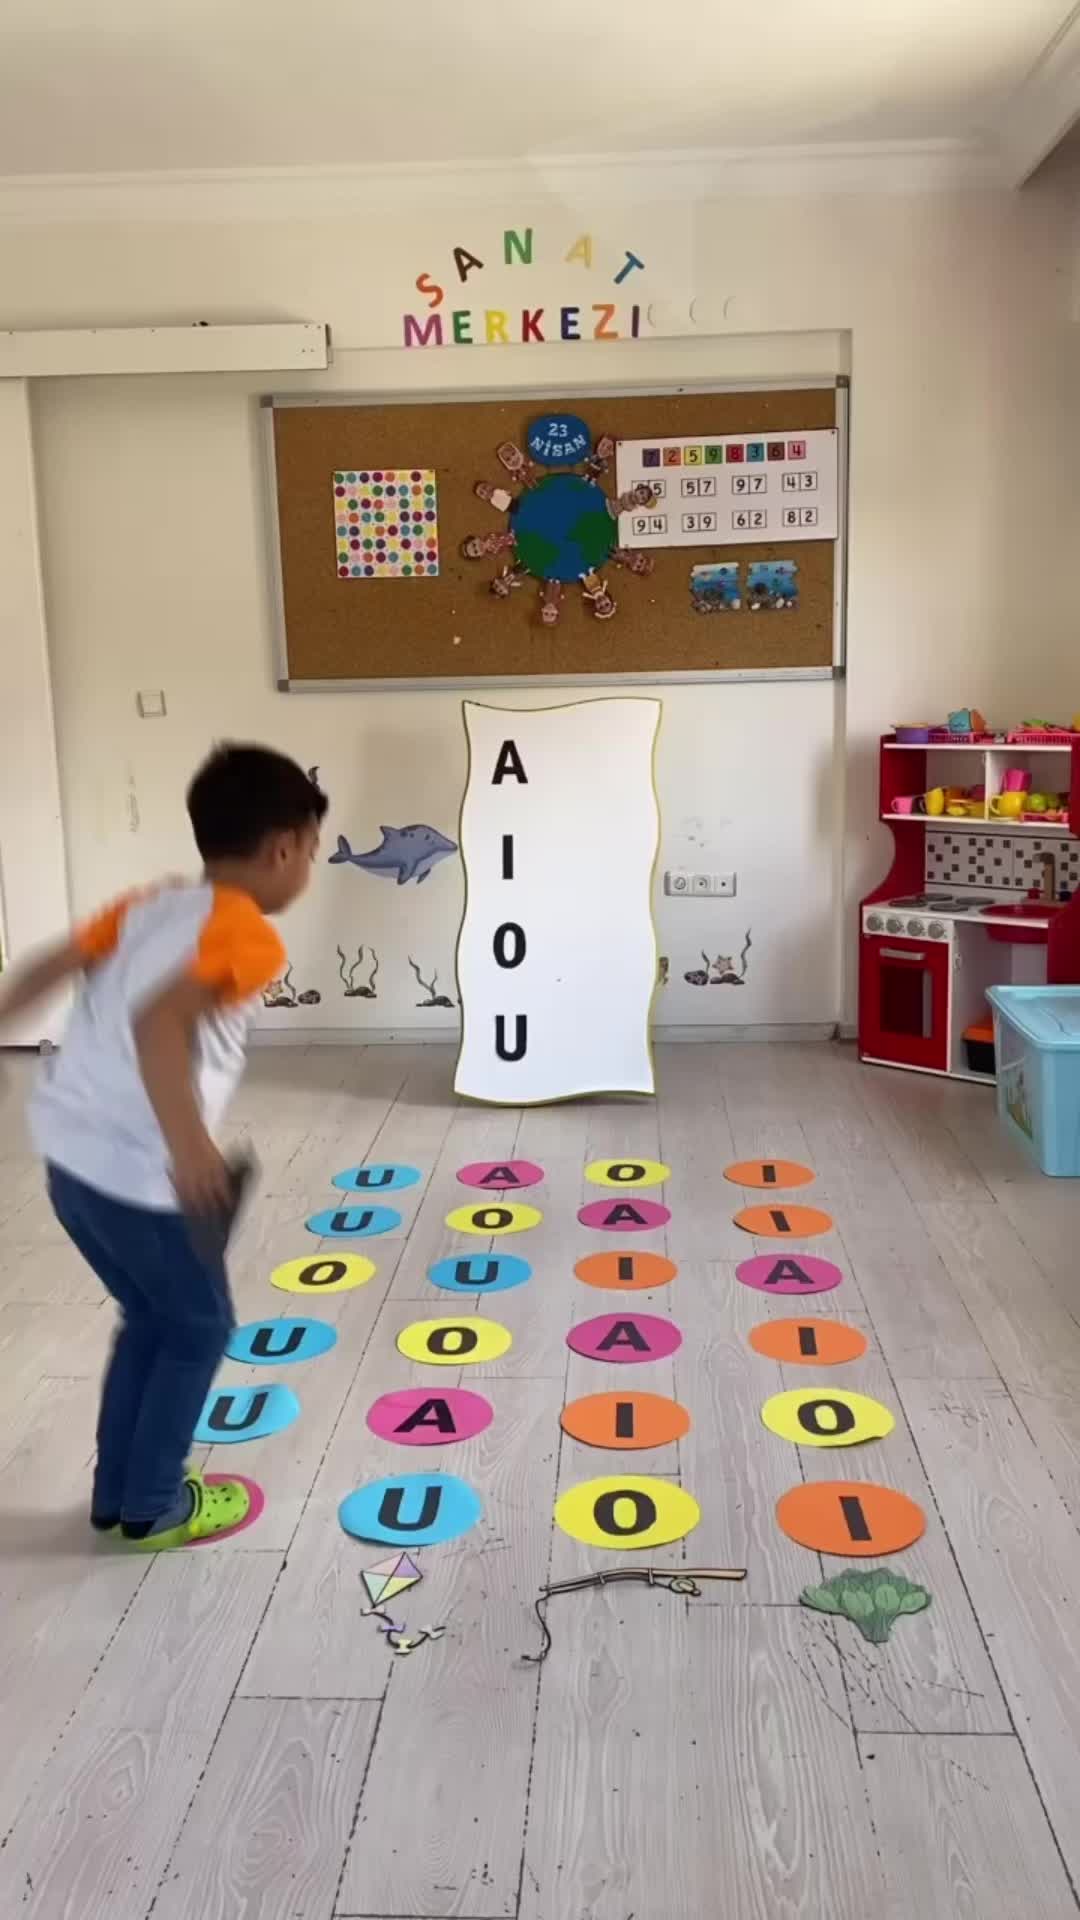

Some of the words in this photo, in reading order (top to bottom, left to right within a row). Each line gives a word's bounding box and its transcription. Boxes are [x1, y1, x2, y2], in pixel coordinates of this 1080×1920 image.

[416, 228, 645, 308] SANAT
[403, 304, 640, 347] MERKEZI
[548, 423, 568, 437] 23
[668, 450, 676, 462] 2
[689, 449, 698, 462] 5
[709, 448, 717, 462] 9
[731, 447, 740, 460] 8
[772, 445, 780, 457] 6
[792, 444, 801, 456] 4
[491, 739, 528, 785] A
[502, 834, 514, 880] I
[492, 922, 527, 969] O
[495, 1014, 527, 1062] U
[356, 1169, 395, 1187] U
[479, 1166, 520, 1184] A
[607, 1164, 646, 1182] O
[762, 1165, 777, 1183] I
[330, 1211, 374, 1232] U
[472, 1208, 514, 1229] O
[603, 1204, 648, 1225] A
[769, 1210, 791, 1232] I
[298, 1261, 347, 1286] O
[454, 1260, 499, 1285] U
[618, 1257, 633, 1280] I
[764, 1260, 815, 1285] A
[250, 1327, 307, 1357] U
[427, 1326, 478, 1356] O
[595, 1321, 652, 1352] A
[798, 1326, 818, 1356] I
[207, 1392, 269, 1431] U
[393, 1398, 457, 1434] A
[616, 1402, 634, 1438] I
[797, 1399, 855, 1436] O
[377, 1486, 443, 1532] U
[593, 1489, 657, 1536] O
[838, 1496, 872, 1541] I
